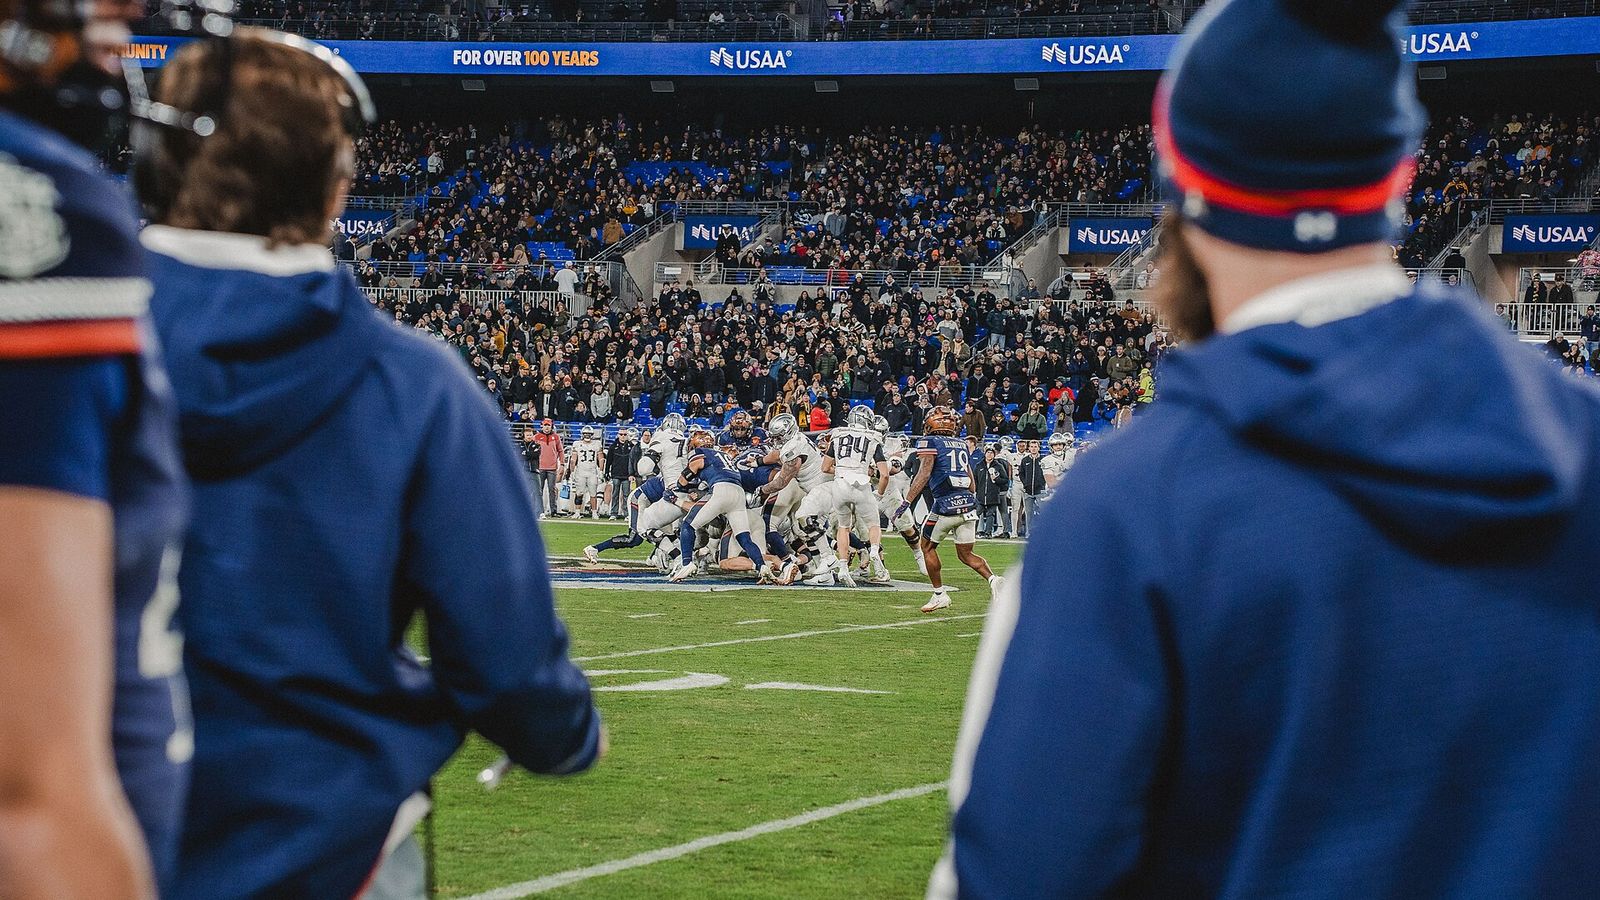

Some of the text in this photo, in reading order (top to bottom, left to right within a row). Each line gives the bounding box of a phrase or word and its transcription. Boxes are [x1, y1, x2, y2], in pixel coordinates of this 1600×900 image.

[453, 50, 599, 67] FOR OVER 100 YEARS
[579, 449, 596, 463] 33
[837, 433, 871, 464] 84
[946, 449, 969, 473] 19
[950, 498, 969, 507] NAVY
